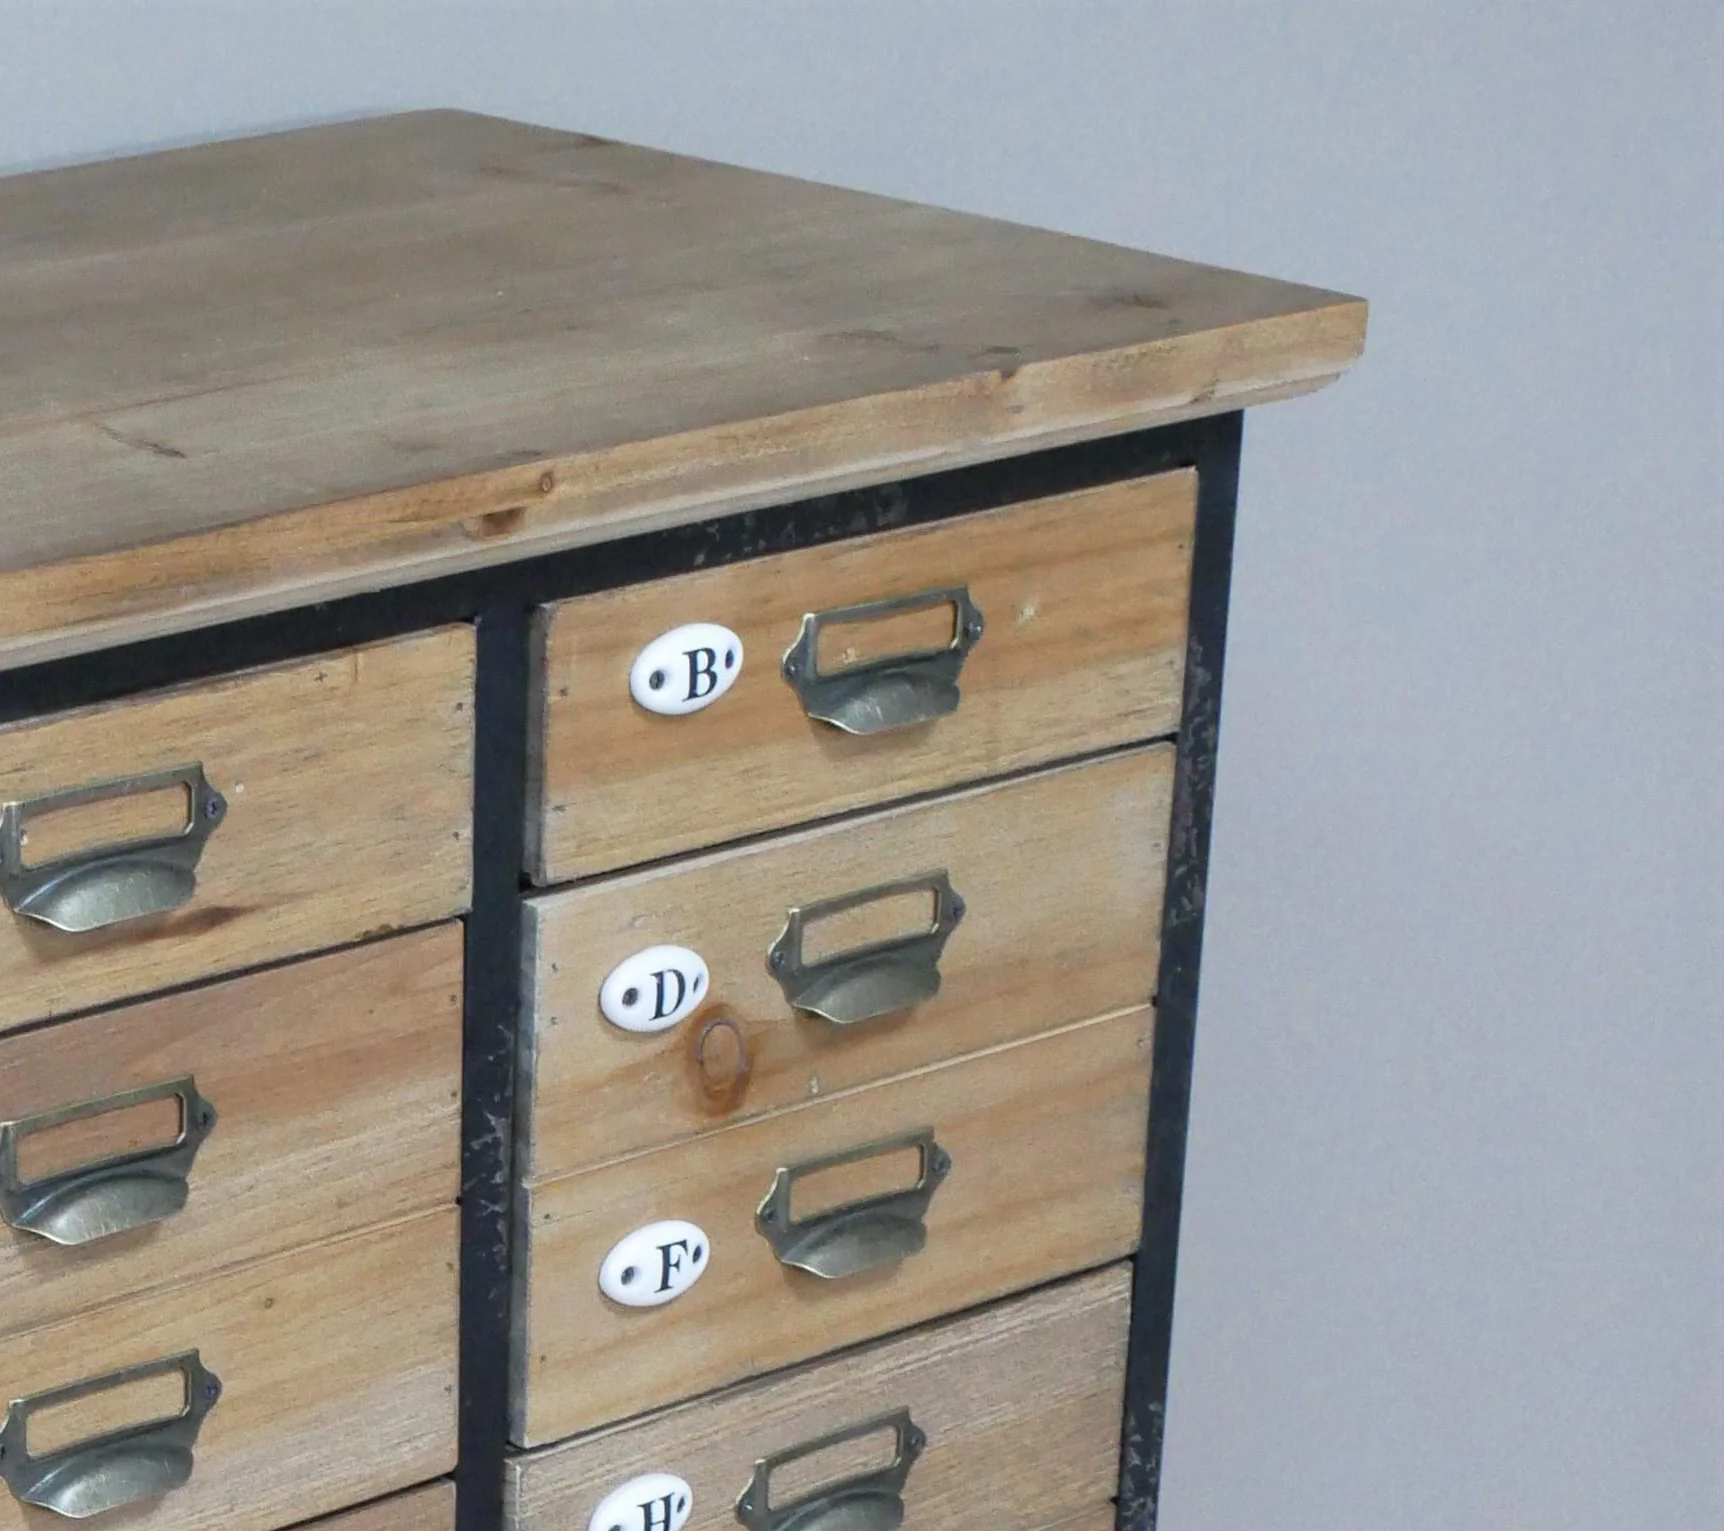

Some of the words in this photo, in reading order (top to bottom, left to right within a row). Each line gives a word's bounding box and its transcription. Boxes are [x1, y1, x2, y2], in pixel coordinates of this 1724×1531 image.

[683, 646, 719, 701] B
[649, 968, 686, 1021] D
[654, 1239, 688, 1293] F
